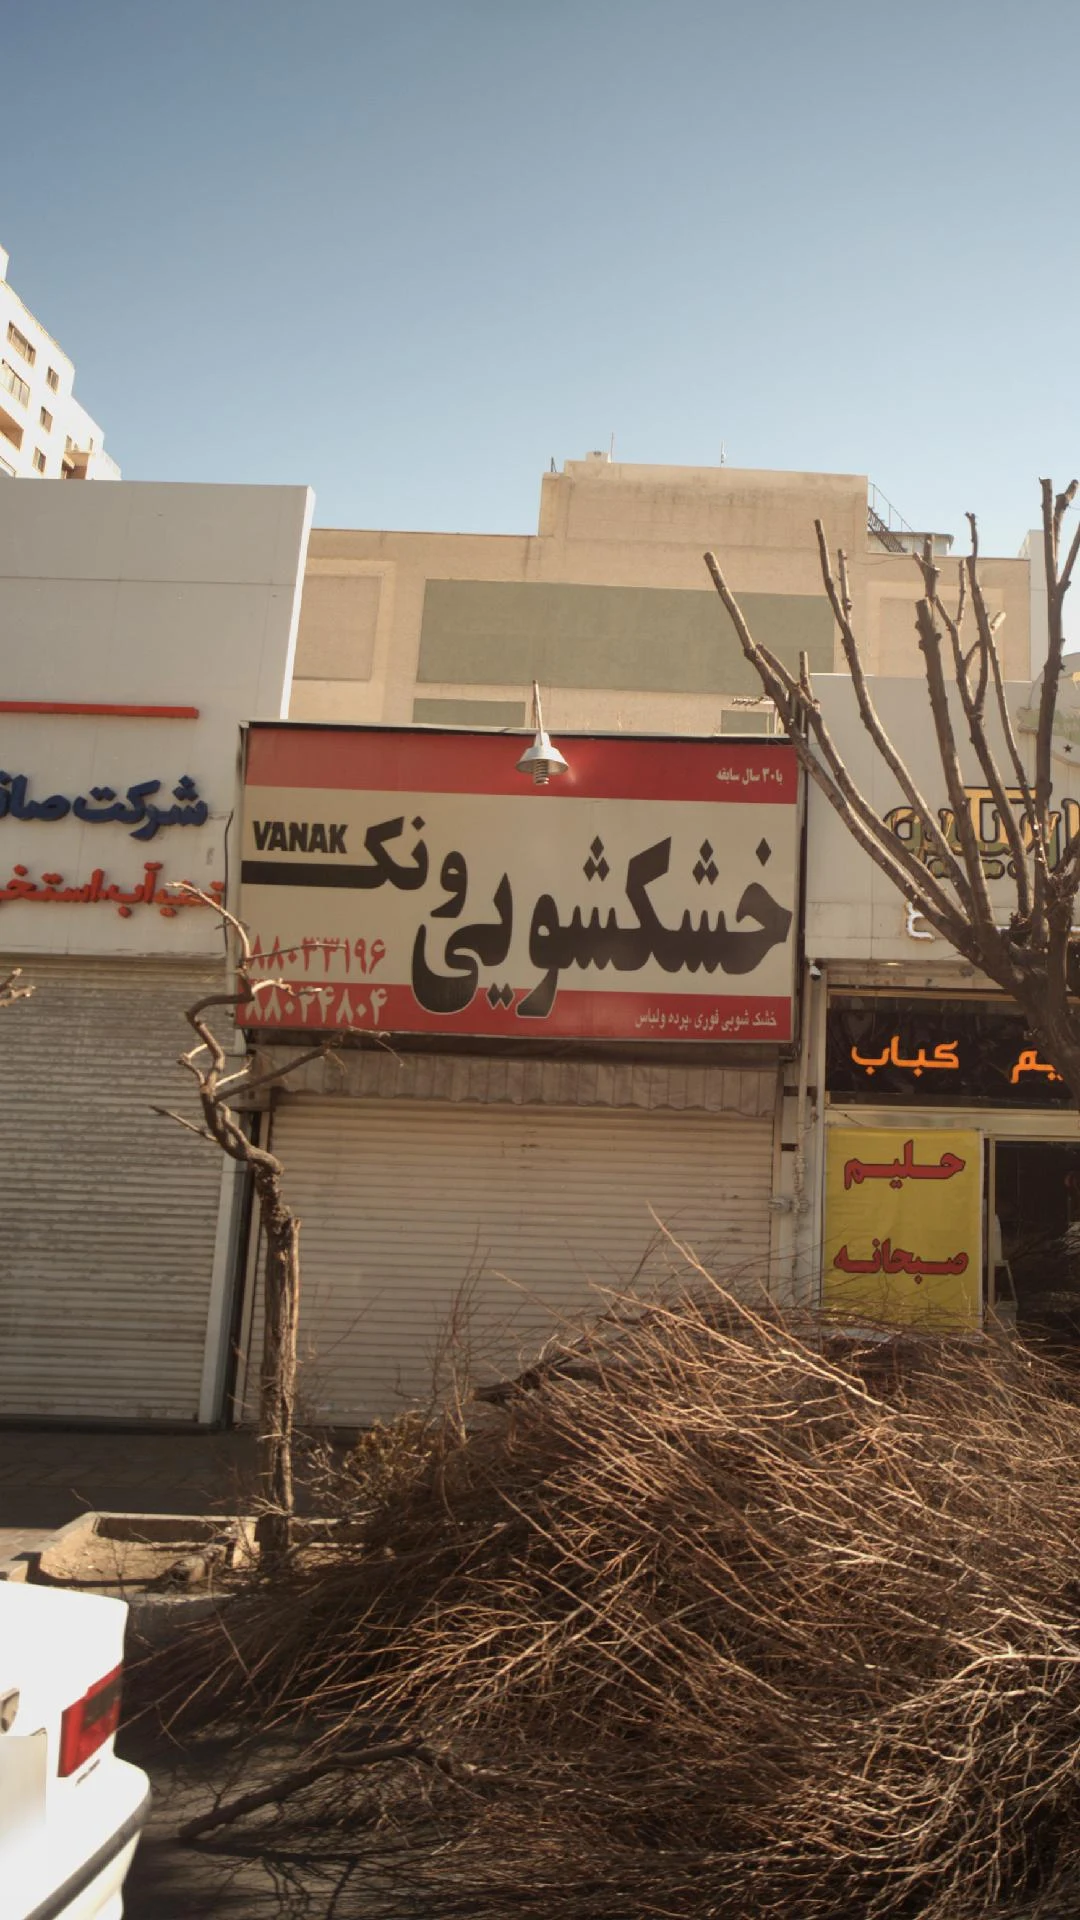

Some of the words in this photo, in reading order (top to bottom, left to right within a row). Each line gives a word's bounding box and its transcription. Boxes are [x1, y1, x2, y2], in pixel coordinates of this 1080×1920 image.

[716, 767, 740, 784] سابقه
[742, 767, 761, 785] سال
[73, 775, 208, 840] شرکت
[252, 820, 349, 854] VANAK
[241, 816, 468, 918] ونک
[411, 835, 793, 1018] خشکشویی
[250, 934, 386, 975] ۸۸۰۳۳۱۹۶
[694, 1008, 720, 1031] فوری
[752, 1010, 777, 1027] خشک
[851, 1035, 960, 1078] کباب
[844, 1139, 966, 1190] حلیم
[833, 1238, 969, 1284] صبحانه
